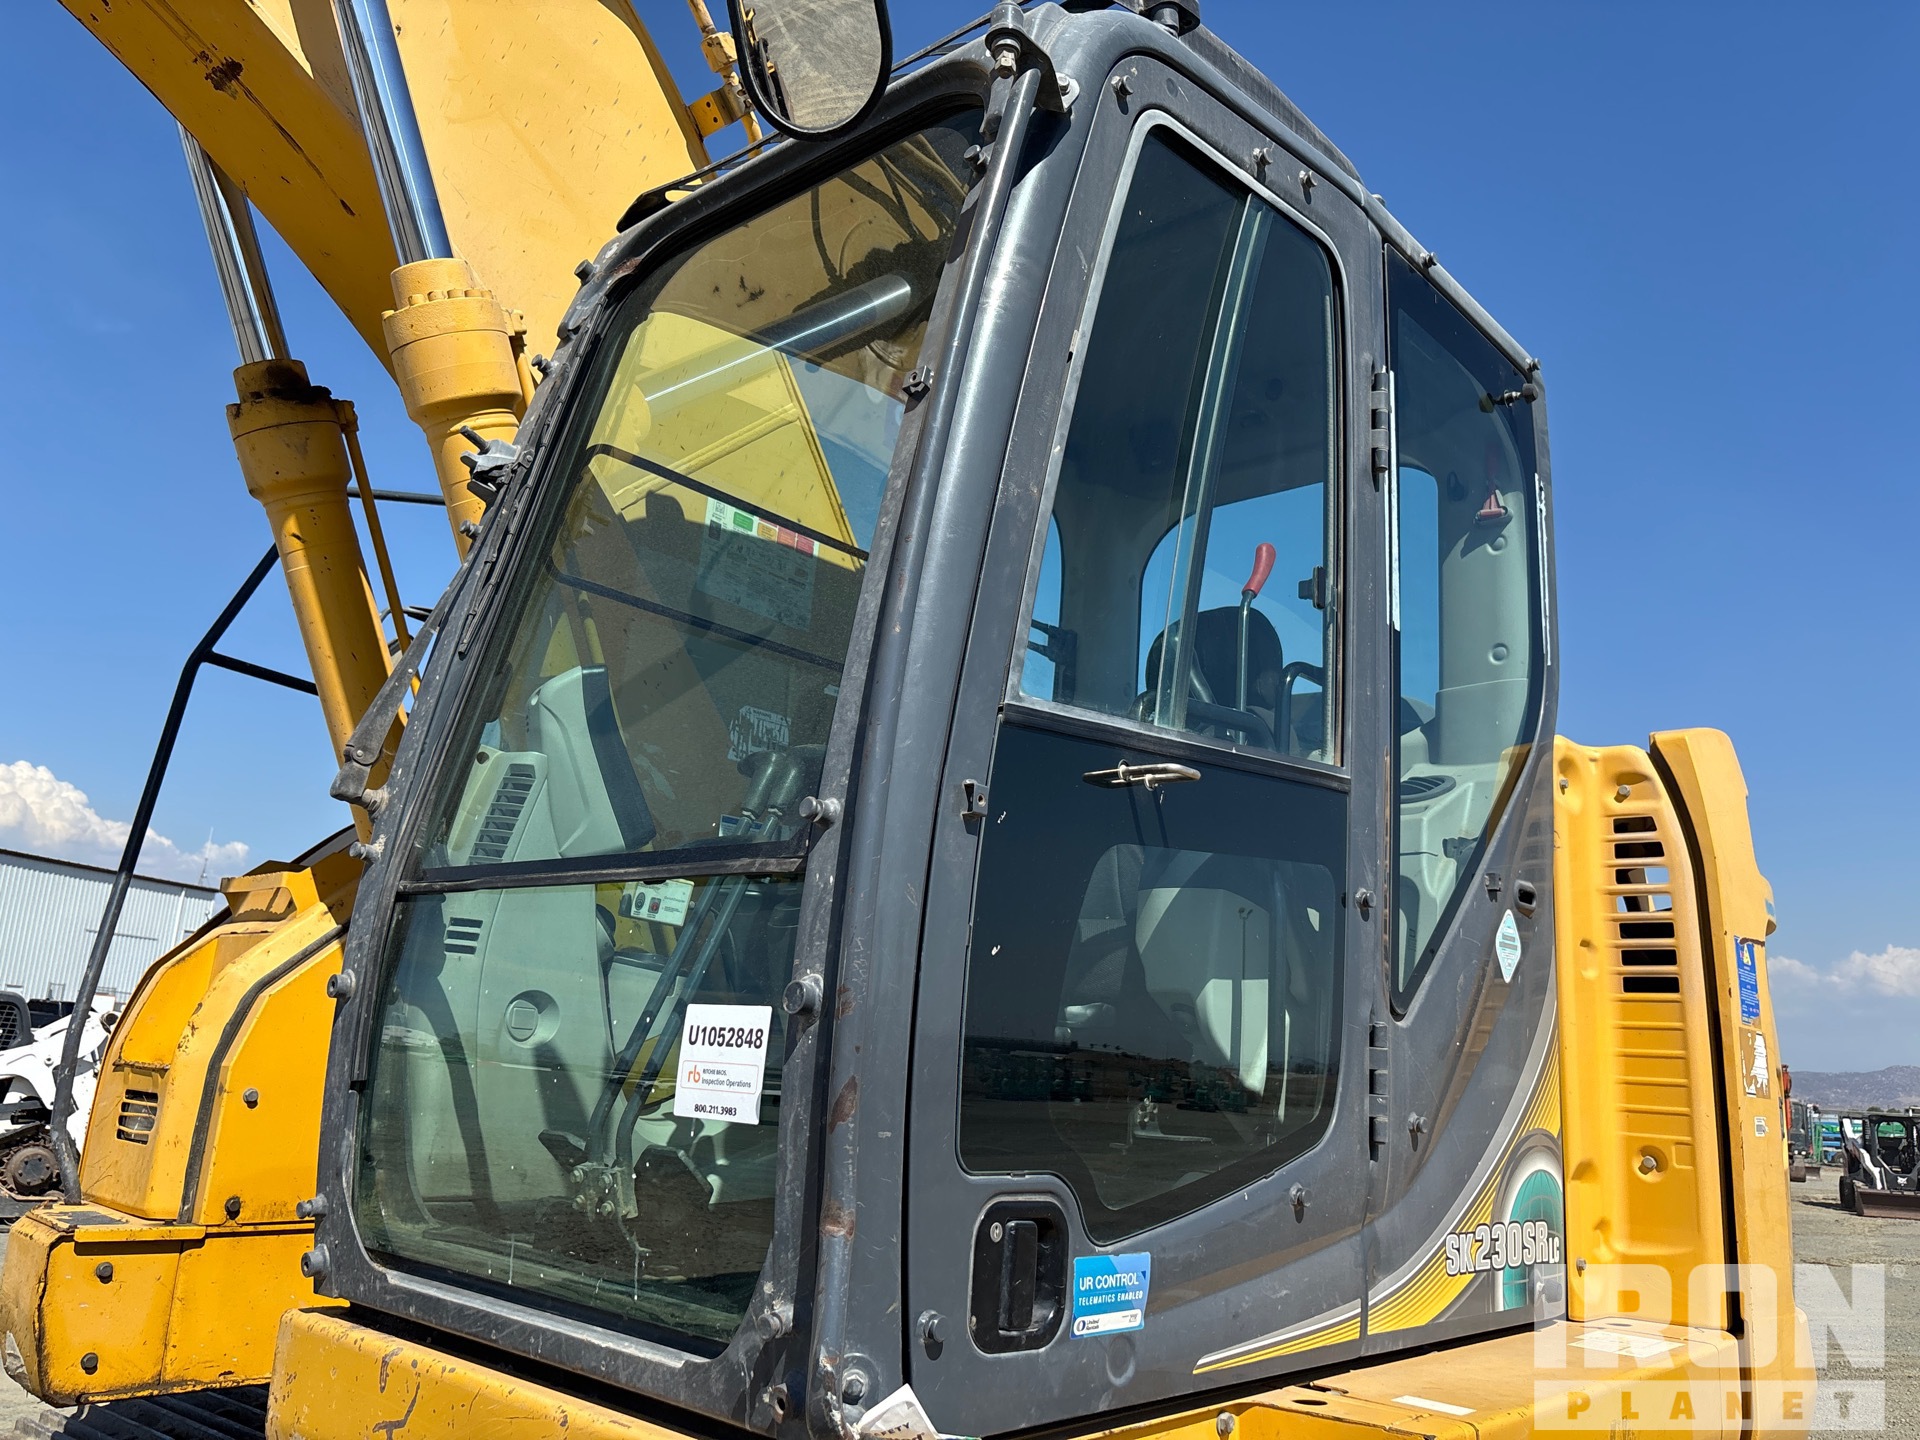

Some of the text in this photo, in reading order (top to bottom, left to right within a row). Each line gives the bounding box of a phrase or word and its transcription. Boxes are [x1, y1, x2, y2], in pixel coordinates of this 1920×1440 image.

[688, 1025, 764, 1049] U1052848
[688, 1065, 700, 1083] rb
[702, 1077, 751, 1088] Inspection Operations
[694, 1103, 737, 1117] 800.211.3983
[1079, 1272, 1139, 1291] UR CONTROL
[1078, 1290, 1143, 1306] TELEMATICS ENABLED
